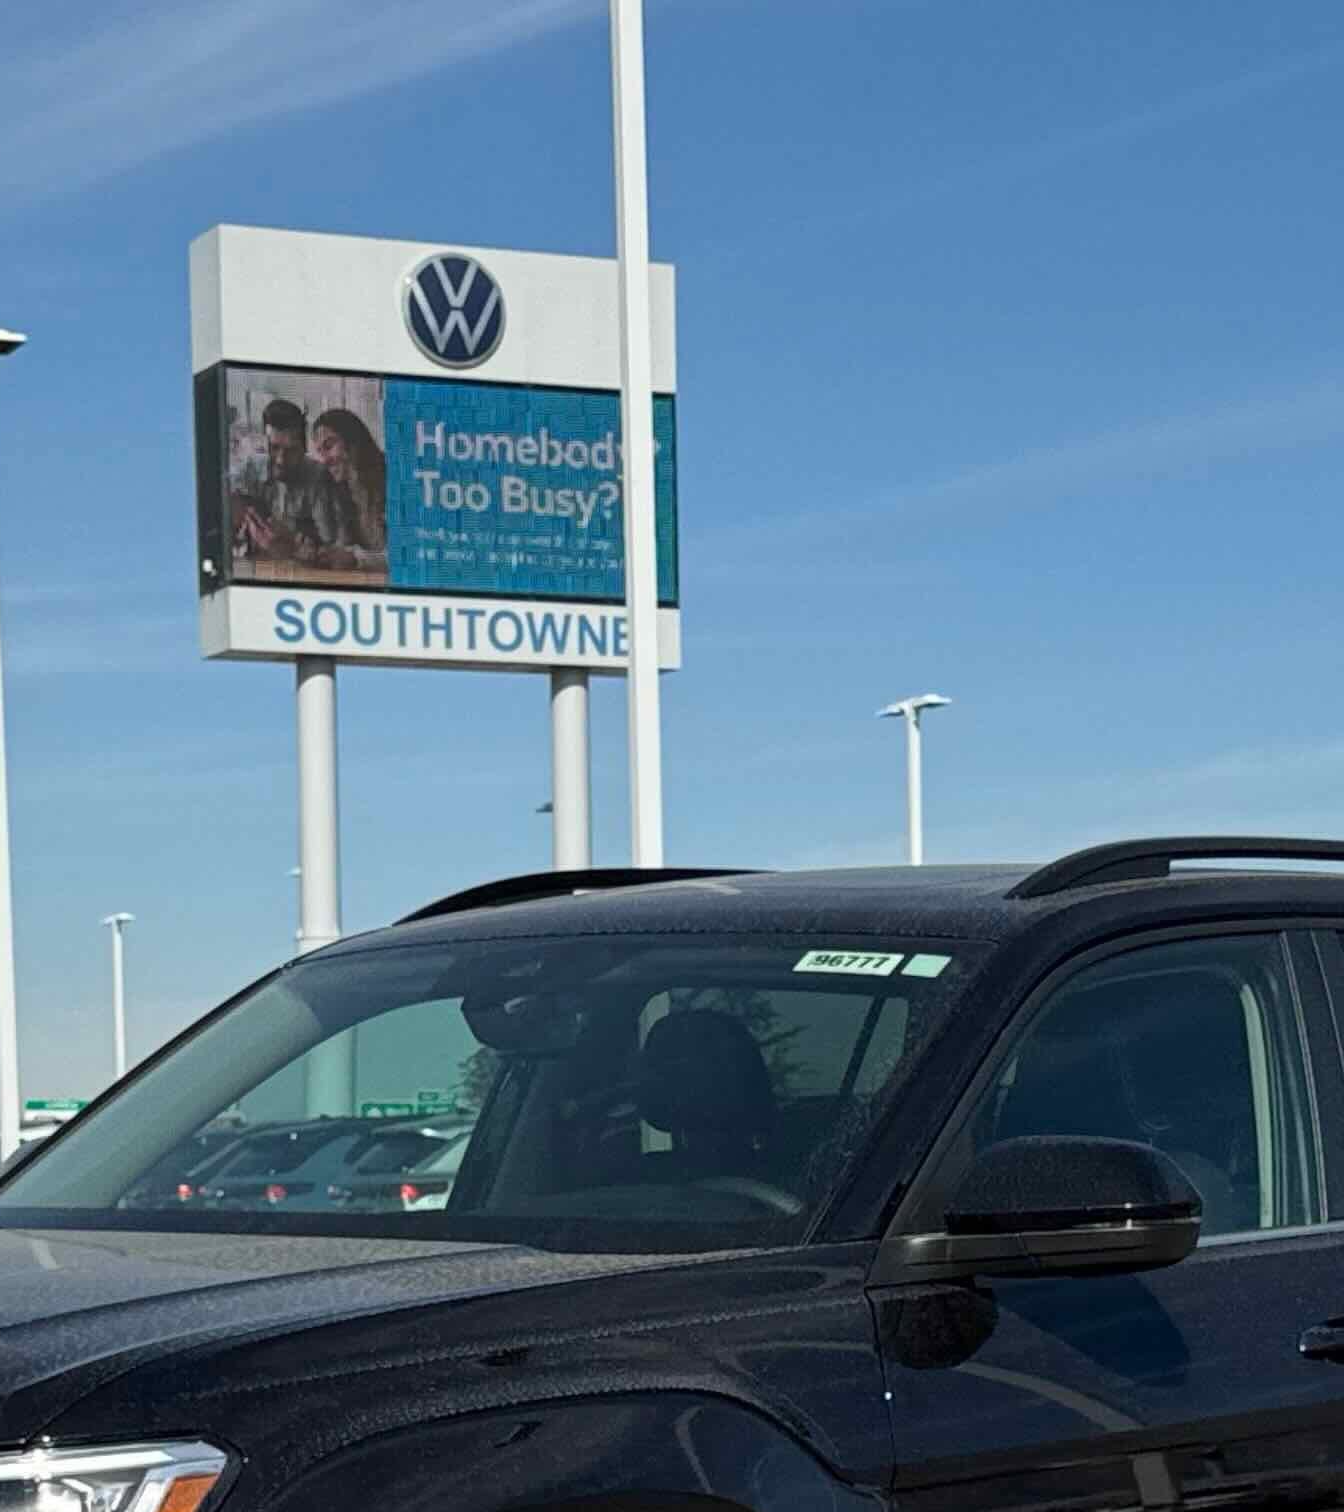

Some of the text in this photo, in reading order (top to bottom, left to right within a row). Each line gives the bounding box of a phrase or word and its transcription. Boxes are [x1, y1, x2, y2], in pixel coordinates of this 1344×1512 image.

[414, 470, 619, 528] Too Busy?
[274, 599, 629, 657] SOUTHTOWNE
[806, 954, 891, 969] 96777
